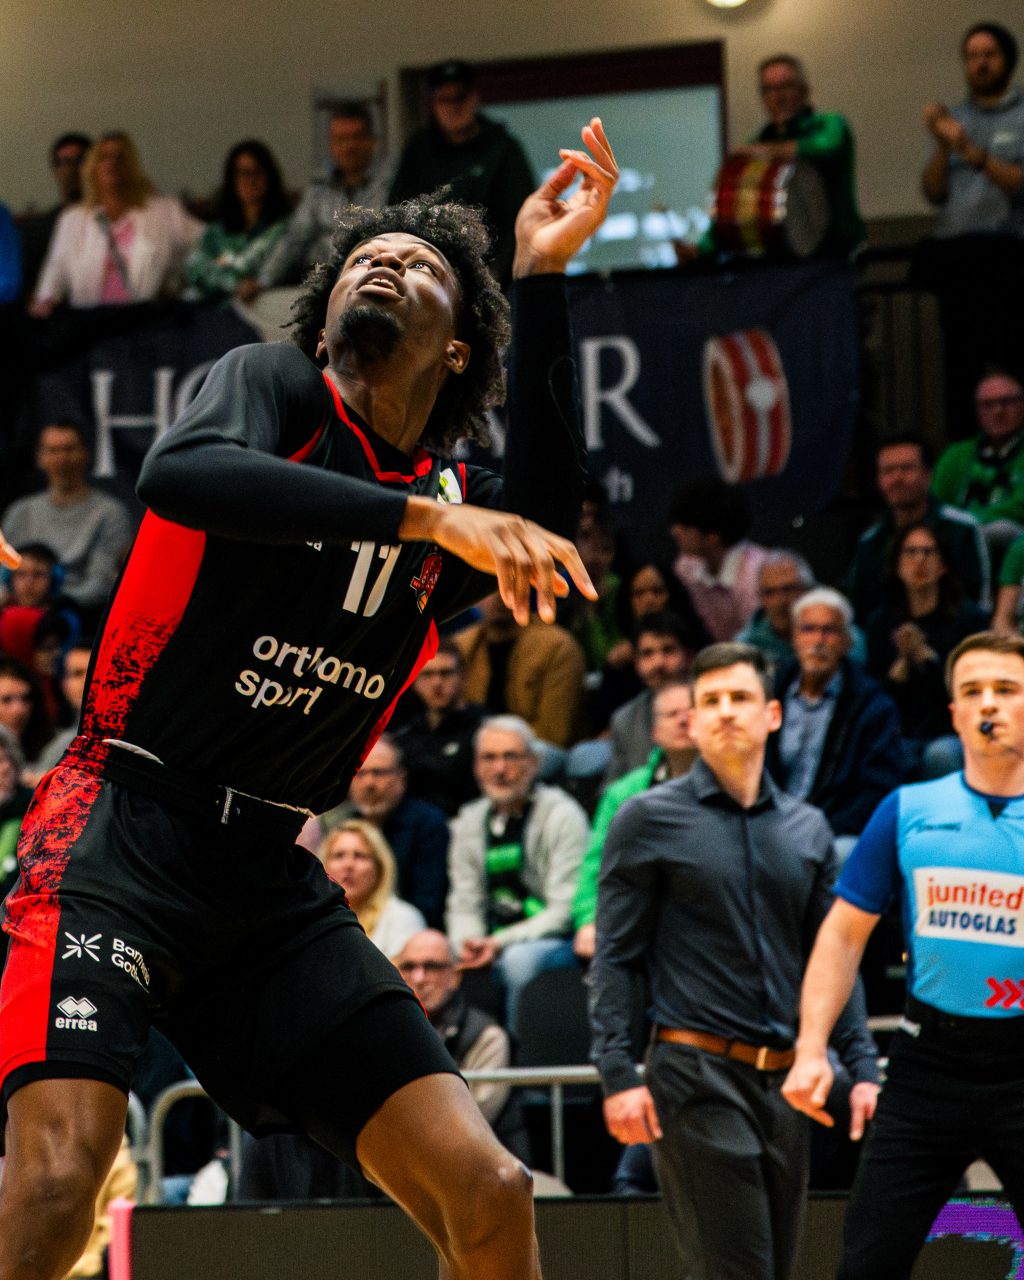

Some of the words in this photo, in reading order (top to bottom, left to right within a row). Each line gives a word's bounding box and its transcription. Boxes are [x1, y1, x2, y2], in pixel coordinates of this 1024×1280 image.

[928, 877, 1024, 912] junited
[928, 909, 1017, 936] AUTOGLAS
[55, 1017, 98, 1032] errea
